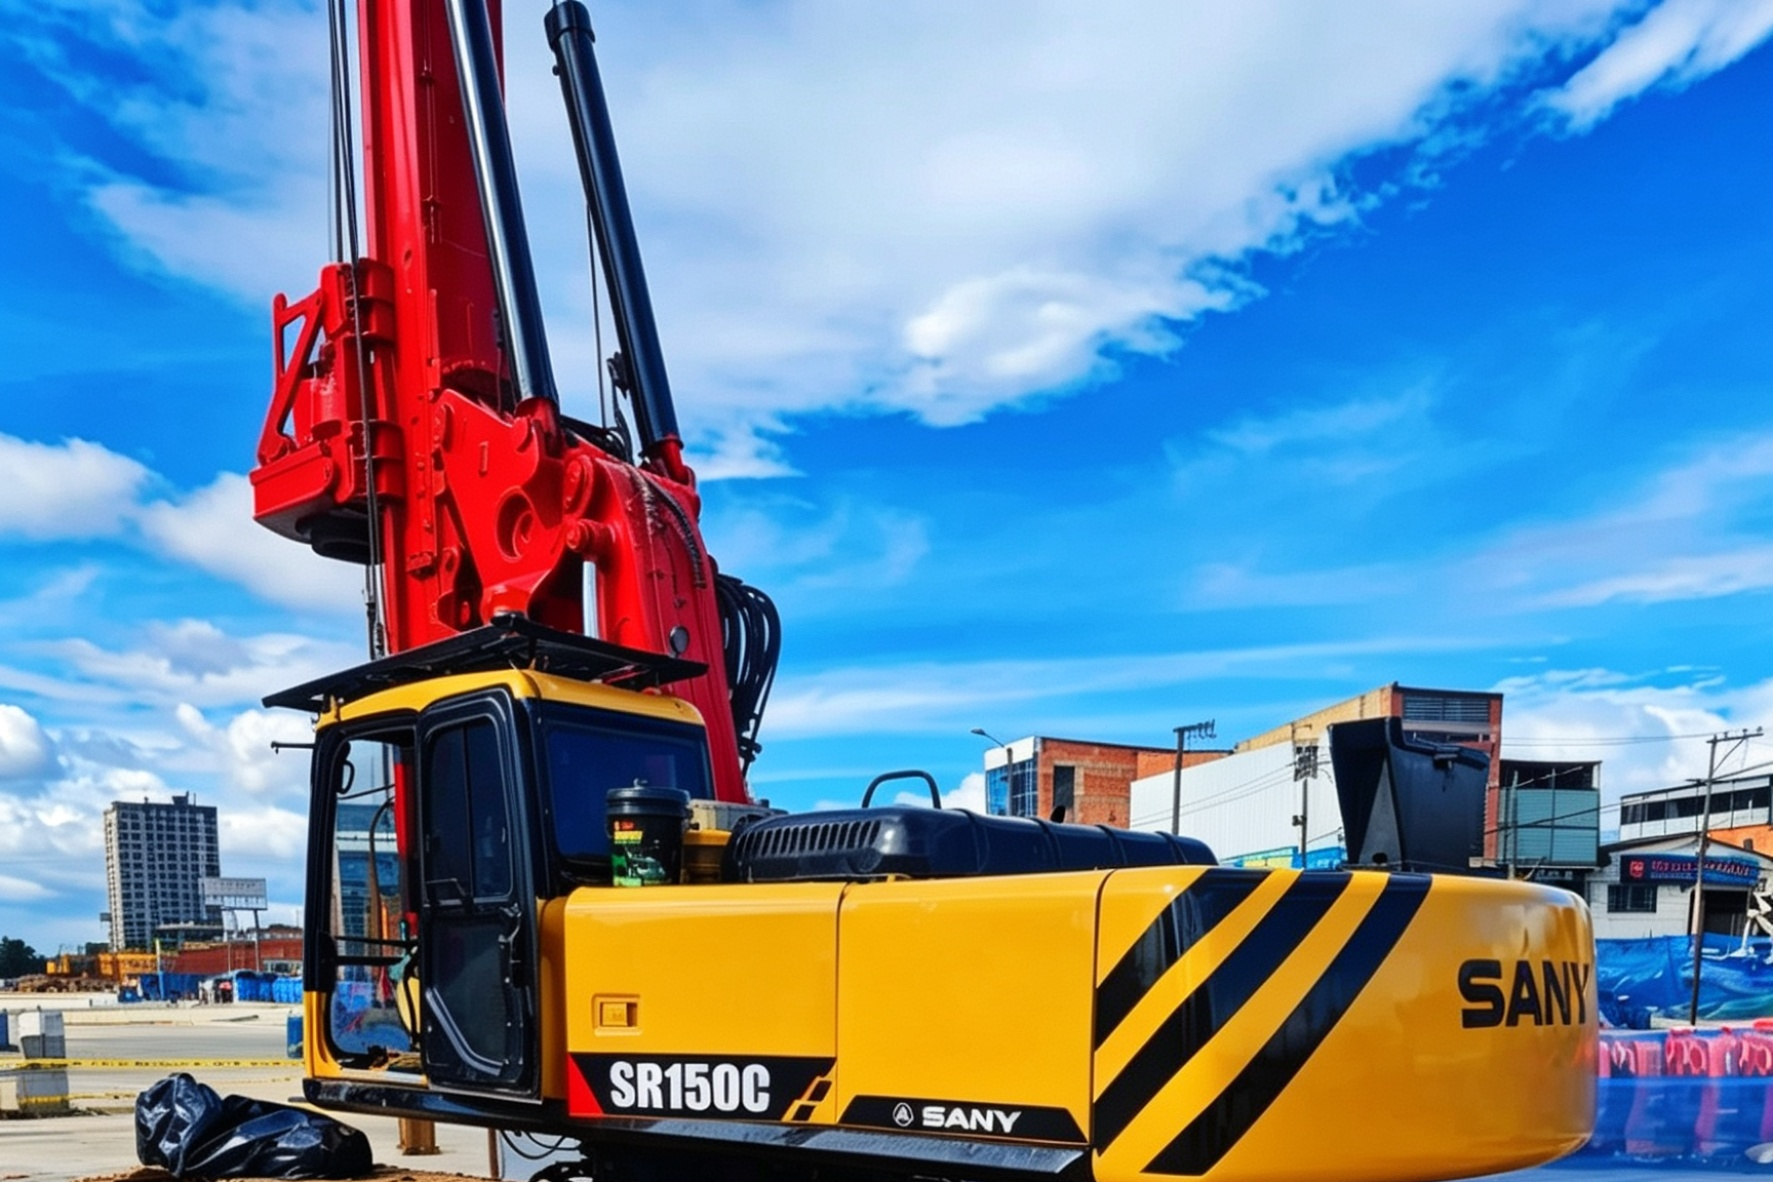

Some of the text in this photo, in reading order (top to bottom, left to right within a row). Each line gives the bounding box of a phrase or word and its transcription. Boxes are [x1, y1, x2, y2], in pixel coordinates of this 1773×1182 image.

[1457, 958, 1590, 1029] SANY
[609, 1060, 771, 1113] SR150C
[921, 1105, 1022, 1134] SANY
